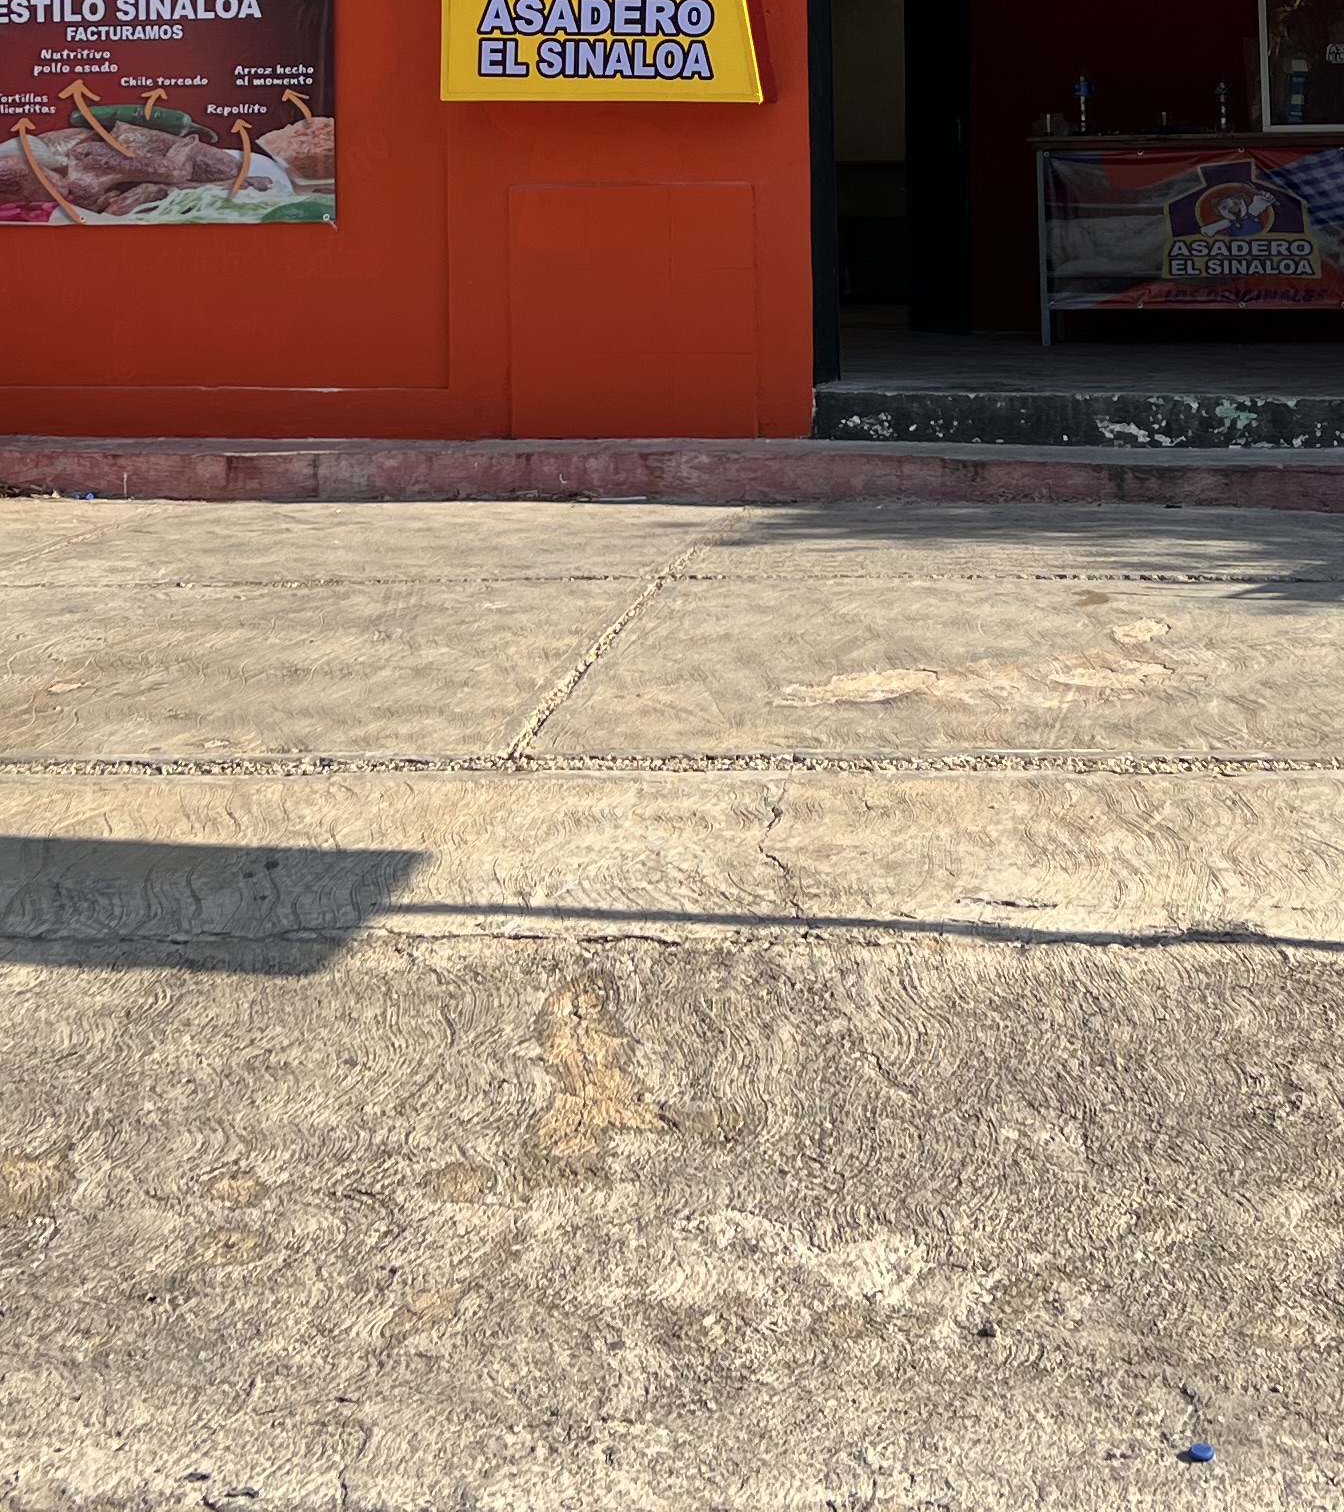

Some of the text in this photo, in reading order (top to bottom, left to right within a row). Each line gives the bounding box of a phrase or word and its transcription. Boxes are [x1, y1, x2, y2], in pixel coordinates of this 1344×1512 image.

[66, 25, 183, 41] FACTURAMOS
[40, 49, 110, 60] Nutritivo
[480, 40, 712, 78] EL SINALOA
[33, 61, 118, 76] pollo asado
[234, 64, 314, 76] Arroz hecho
[121, 75, 208, 86] Chile toreado
[236, 75, 313, 86] al momento
[206, 104, 267, 116] Repollito
[1169, 239, 1313, 257] ASADERO
[1169, 258, 1313, 276] EL SINALOA
